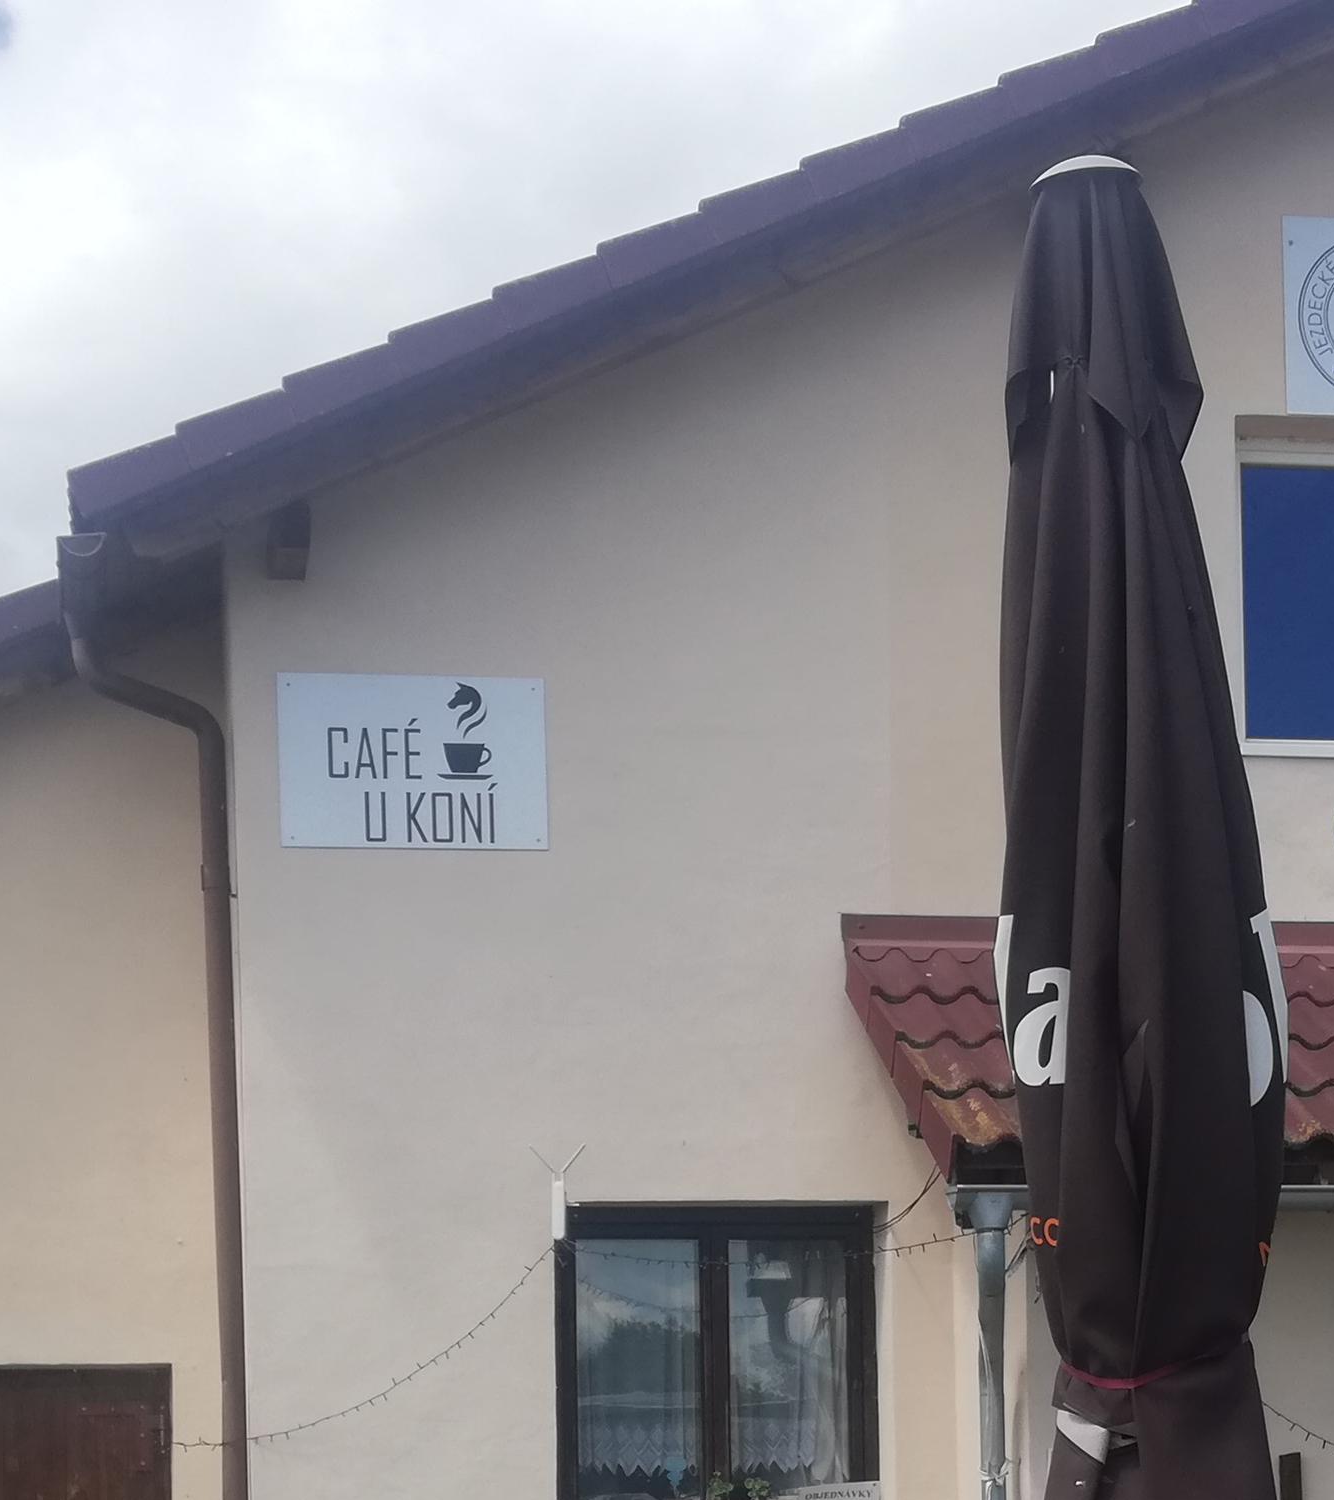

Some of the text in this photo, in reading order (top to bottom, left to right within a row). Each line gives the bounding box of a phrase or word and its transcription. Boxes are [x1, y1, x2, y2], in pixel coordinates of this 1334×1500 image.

[327, 718, 423, 780] CAFÉ
[364, 782, 499, 843] U KONÍ
